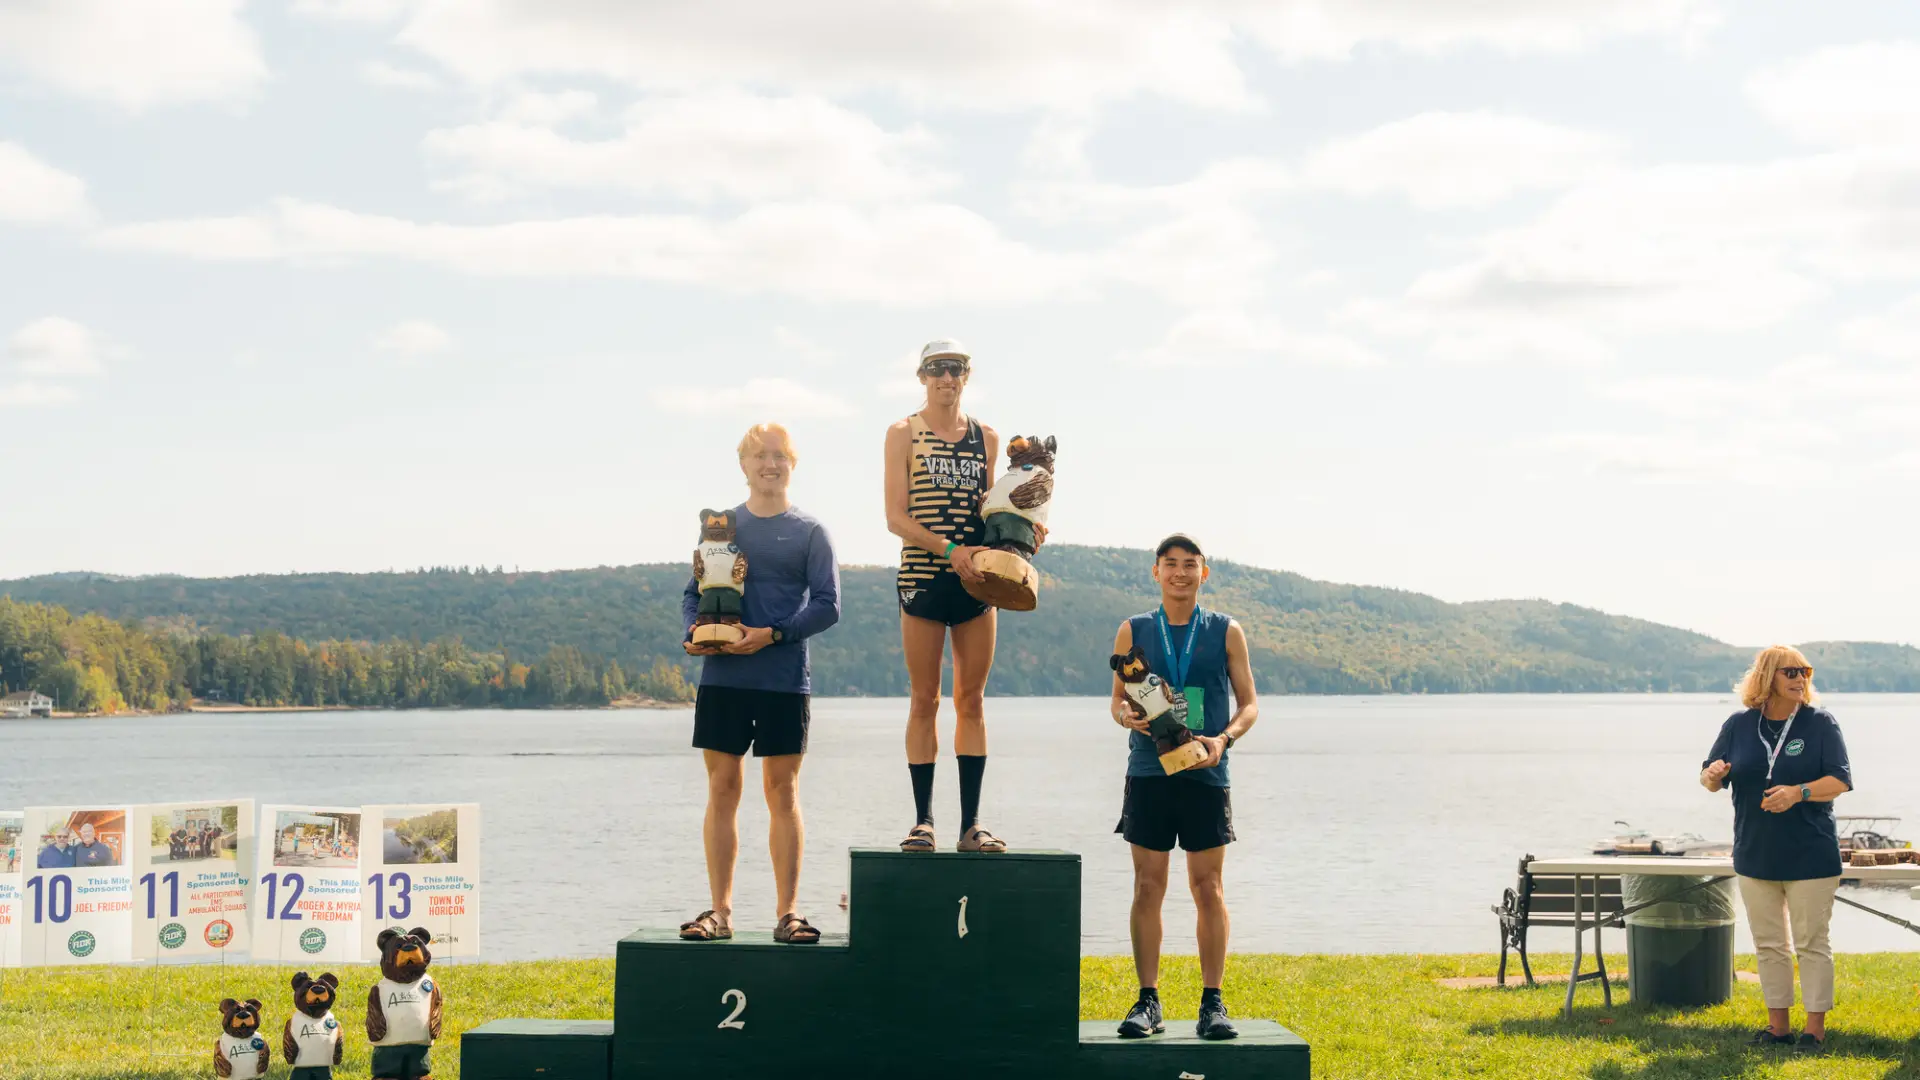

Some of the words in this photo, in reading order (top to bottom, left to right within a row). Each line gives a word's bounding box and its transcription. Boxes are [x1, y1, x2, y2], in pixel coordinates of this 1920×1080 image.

[924, 457, 981, 478] VALOR
[931, 476, 958, 486] TRACK
[961, 477, 978, 488] CLUB
[187, 879, 236, 889] Sponsored
[238, 878, 250, 886] by
[412, 883, 461, 891] Sponsored
[77, 885, 127, 894] Sponsored
[203, 890, 244, 899] PARTICIPATING
[308, 886, 356, 894] Sponsored
[27, 874, 72, 924] 10
[140, 871, 178, 919] 11
[261, 872, 304, 920] 12
[368, 872, 411, 920] 13
[429, 895, 452, 905] TOWN
[454, 895, 465, 905] OF
[74, 903, 94, 913] JOEL
[189, 905, 222, 914] AMBULANCE
[297, 900, 325, 910] ROGER
[327, 901, 333, 910] &
[311, 911, 353, 921] FRIEDMAN
[429, 906, 465, 916] HORICON
[957, 895, 969, 938] 1
[717, 989, 747, 1029] 2
